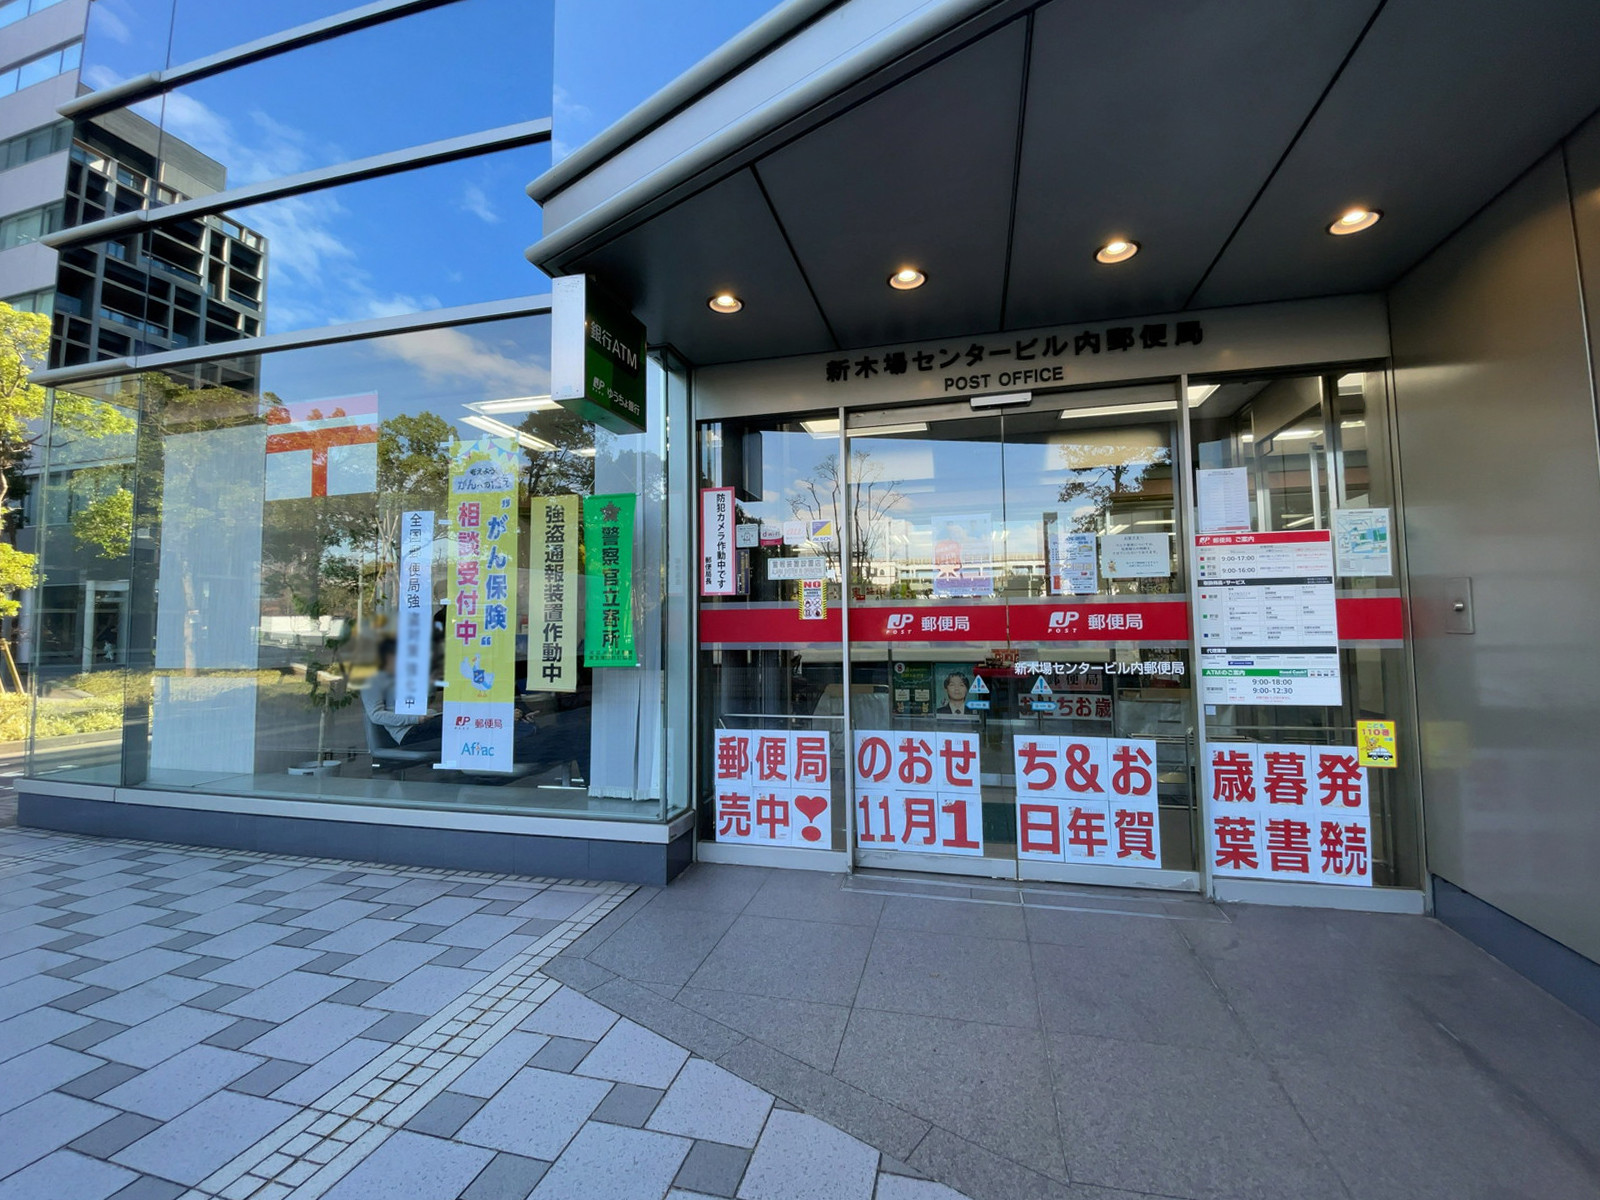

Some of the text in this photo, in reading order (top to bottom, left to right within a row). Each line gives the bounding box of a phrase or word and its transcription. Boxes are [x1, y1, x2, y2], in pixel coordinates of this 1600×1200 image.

[591, 321, 637, 370] 銀行ATM
[826, 320, 1204, 382] 新木場センタービル内郵便局
[943, 366, 1064, 391] POST OFFICE
[716, 493, 727, 589] 防犯カメラ作動中です
[456, 502, 481, 646] 相談受付中
[541, 504, 566, 684] 強盗通報装置作動中
[601, 526, 621, 649] 警察官立寄所
[704, 556, 713, 585] 郵便局長
[921, 616, 970, 632] 郵便局
[1088, 613, 1143, 630] 郵便局
[1014, 661, 1185, 676] 新木場センタービル内郵便局
[475, 717, 503, 730] 郵便局
[461, 741, 495, 757] Aflac
[718, 736, 1363, 808] 郵便局 のおせ ち&お 歳暮発
[719, 791, 790, 839] 売中
[859, 795, 980, 849] 11月1
[1019, 803, 1157, 860] 日年賀
